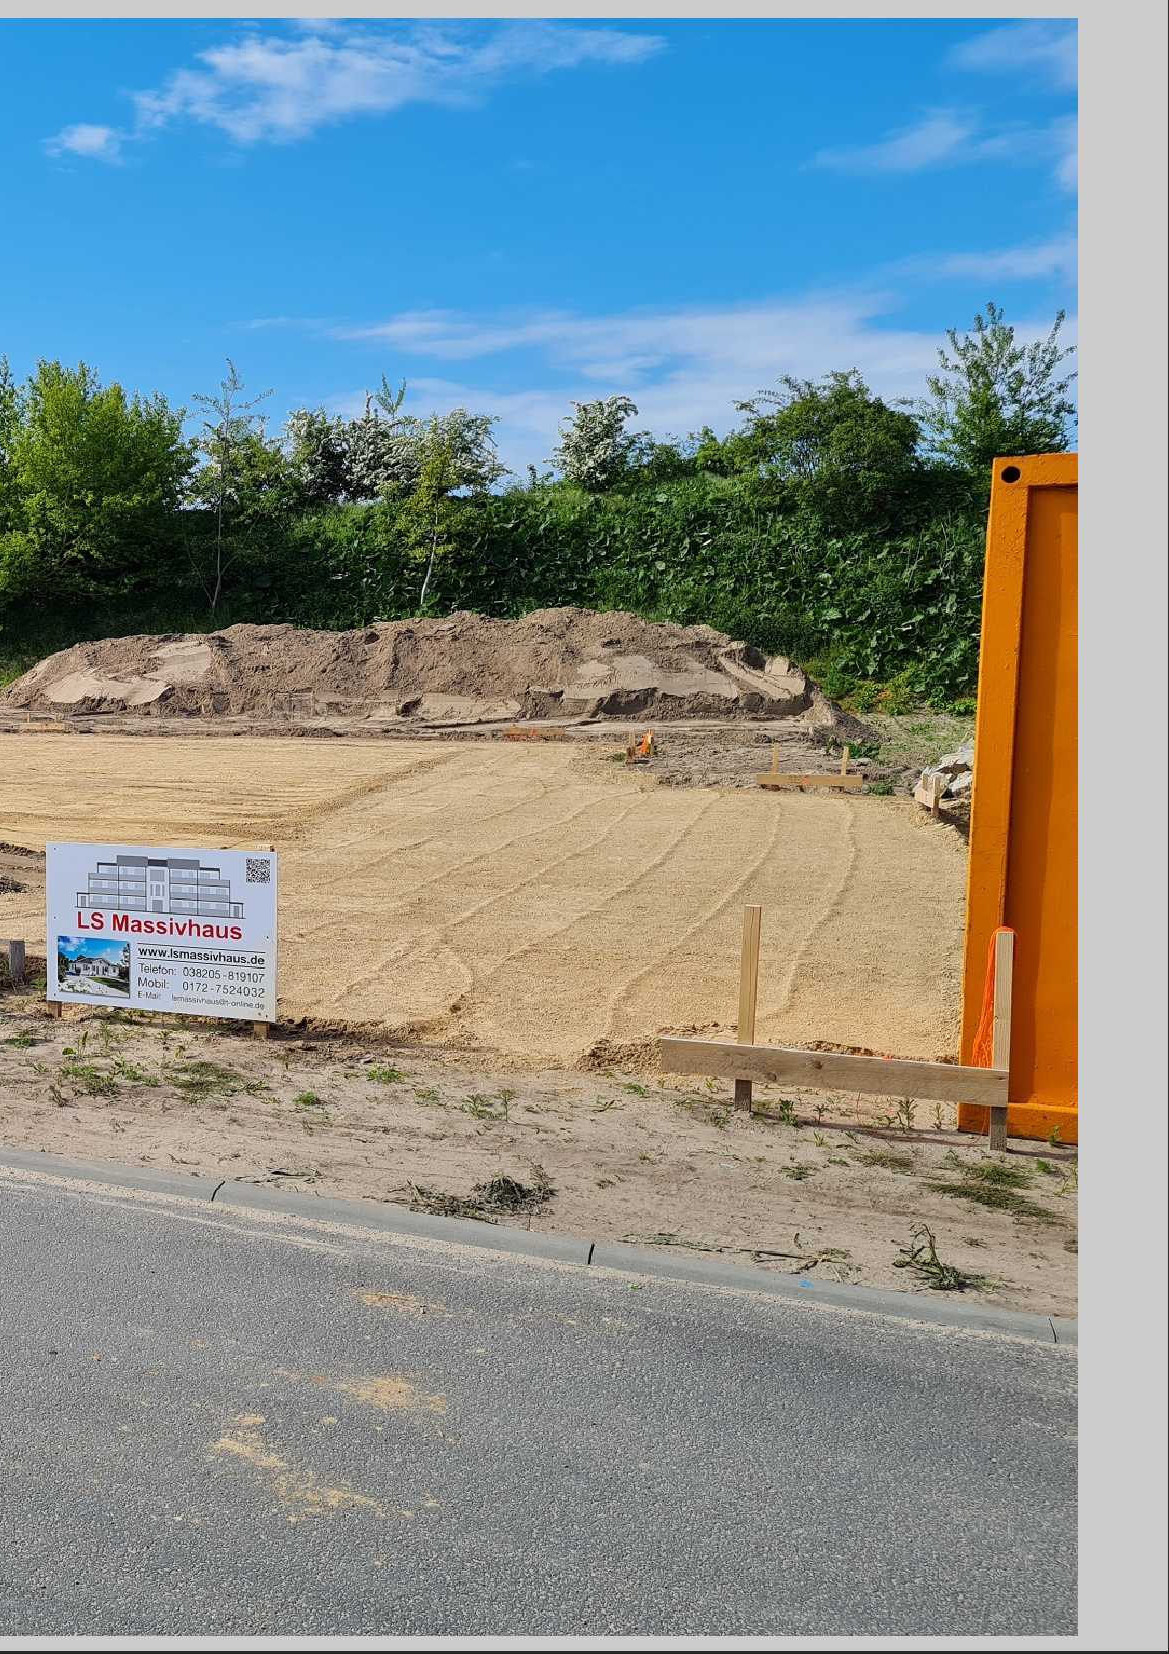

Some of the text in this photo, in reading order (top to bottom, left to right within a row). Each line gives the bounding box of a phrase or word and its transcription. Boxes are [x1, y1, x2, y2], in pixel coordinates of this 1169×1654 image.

[77, 911, 242, 940] LS Massivhaus
[137, 947, 265, 965] www.lsmassivhaus.de
[139, 963, 176, 976] Telefon:
[137, 977, 169, 989] Mobil:
